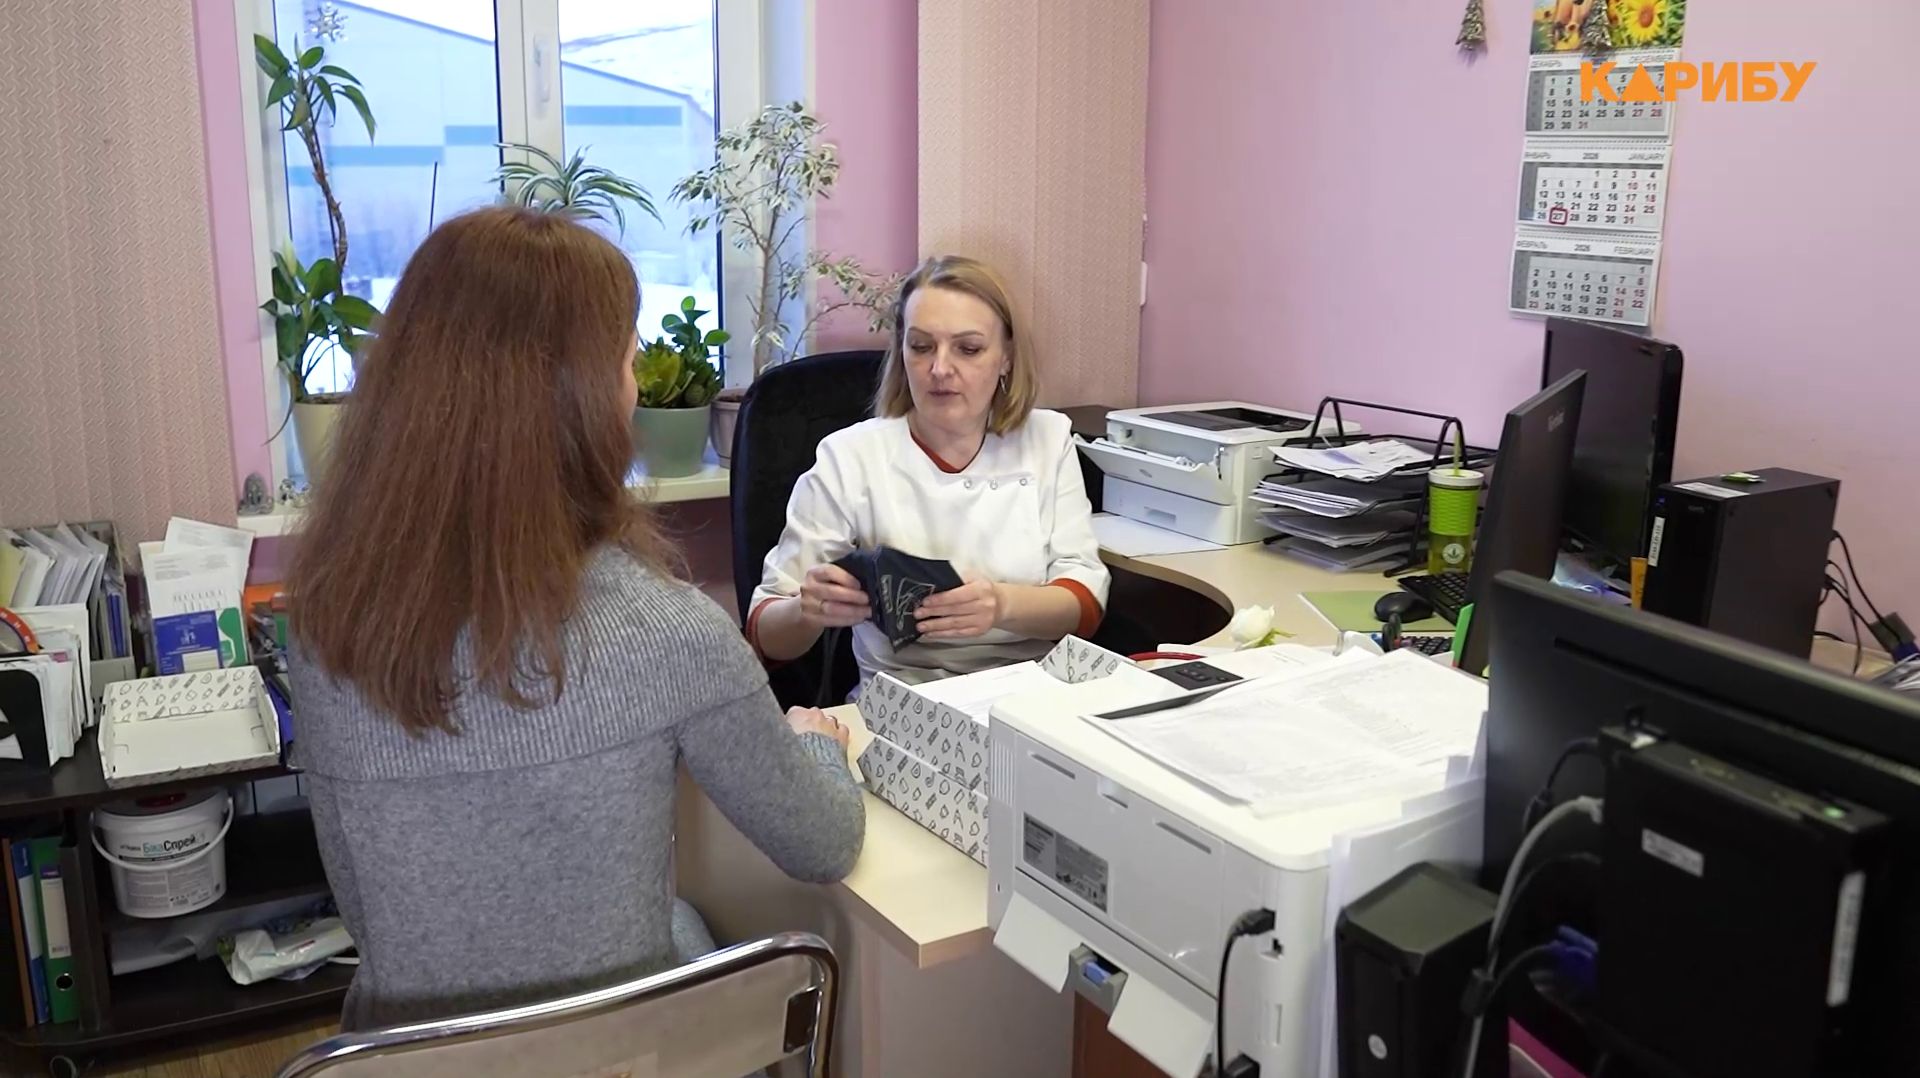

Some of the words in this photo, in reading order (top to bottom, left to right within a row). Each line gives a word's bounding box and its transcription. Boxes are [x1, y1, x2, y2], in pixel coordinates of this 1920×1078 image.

[1563, 99, 1572, 107] 16
[1545, 110, 1555, 118] 22
[1562, 110, 1572, 118] 23
[1579, 110, 1589, 118] 24
[1632, 109, 1643, 117] 27
[1651, 109, 1663, 117] 28
[1578, 121, 1588, 129] 31
[1613, 170, 1618, 178] 2
[1628, 182, 1638, 190] 10
[1647, 183, 1656, 191] 11
[1608, 193, 1618, 201] 16
[1588, 203, 1598, 211] 22
[1606, 204, 1617, 212] 23
[1644, 205, 1655, 213] 25
[1587, 214, 1598, 222] 29
[1605, 215, 1615, 223] 30
[1624, 216, 1634, 224] 31
[1614, 247, 1655, 255] FEBRUARY
[1584, 273, 1590, 281] 5
[1619, 276, 1625, 284] 7
[1547, 281, 1557, 289] 10
[1598, 286, 1608, 294] 13
[1634, 289, 1645, 297] 15
[1580, 295, 1589, 303] 19
[1597, 297, 1607, 305] 20
[1561, 304, 1571, 312] 25
[1595, 308, 1606, 316] 27
[1613, 310, 1623, 318] 28
